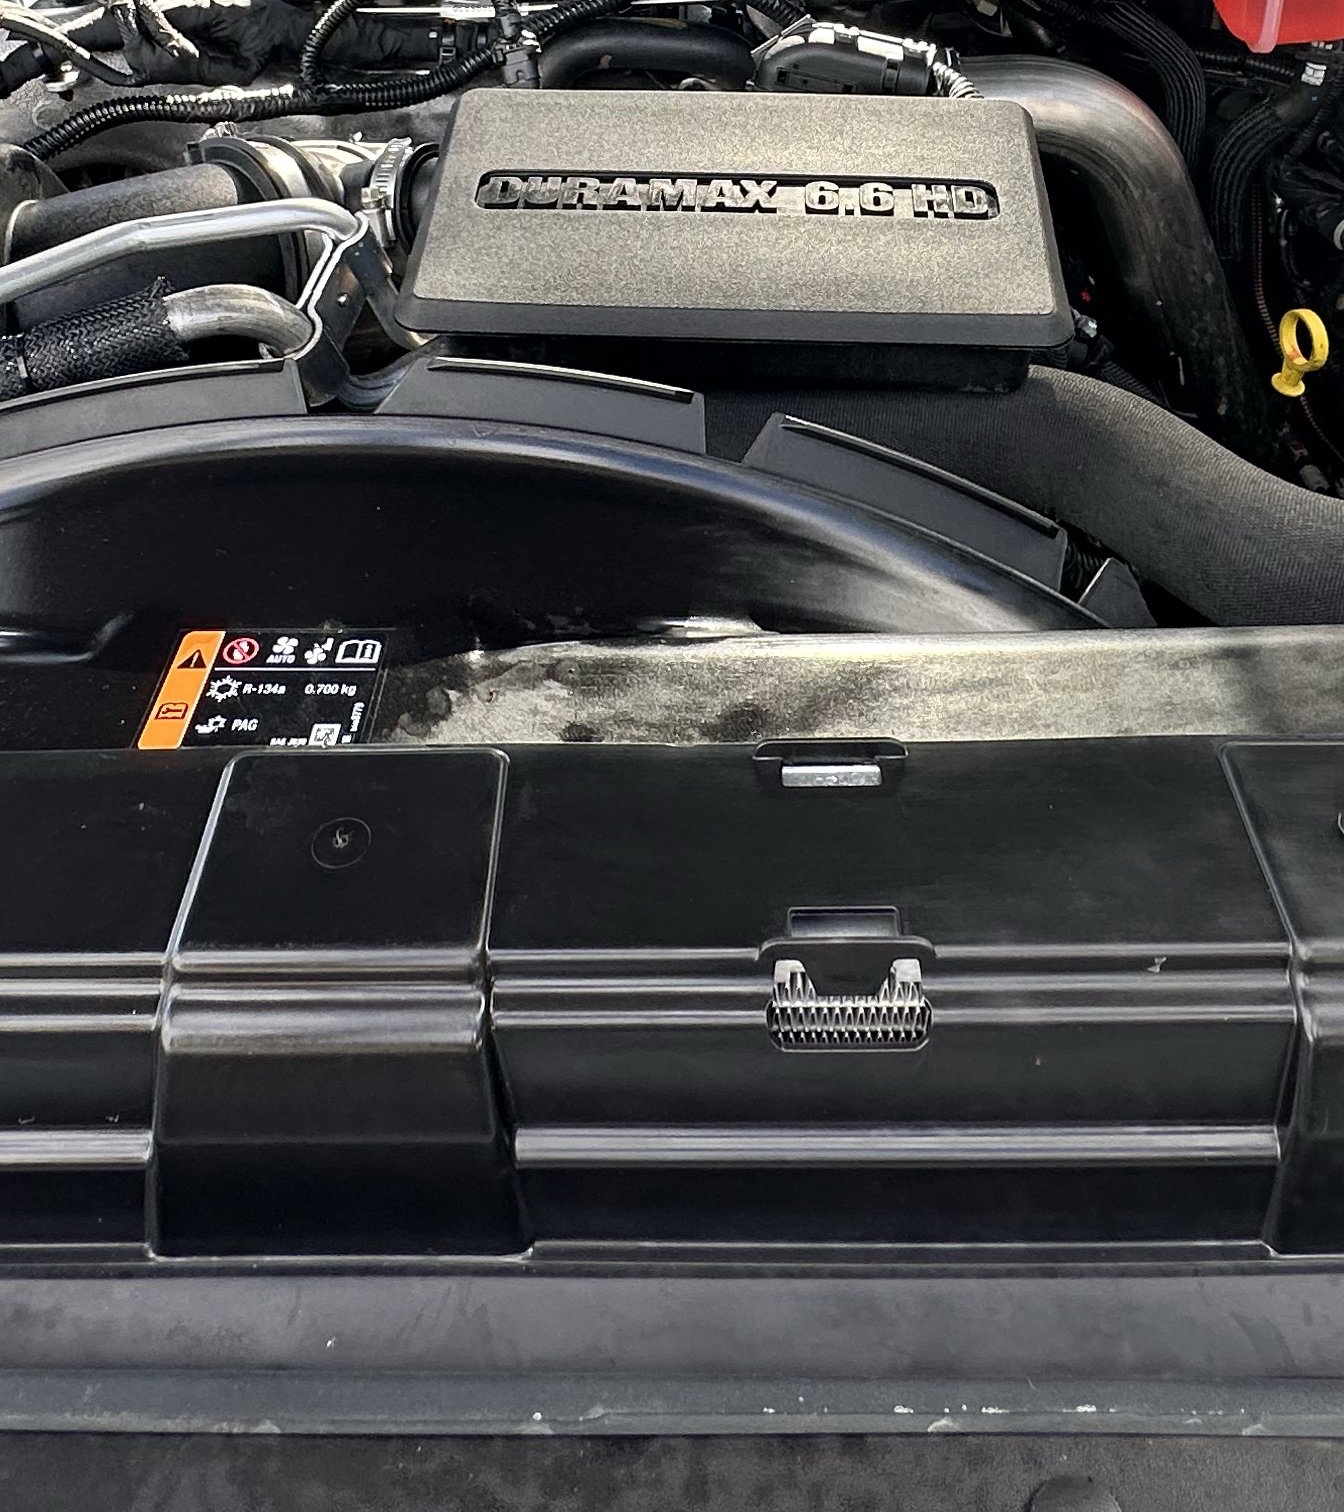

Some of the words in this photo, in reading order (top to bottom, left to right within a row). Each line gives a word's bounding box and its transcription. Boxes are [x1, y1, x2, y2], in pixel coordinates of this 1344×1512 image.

[478, 175, 778, 211] DURAMAX
[805, 180, 895, 215] 6.6
[910, 183, 990, 218] HD
[265, 654, 296, 664] AUTO
[242, 683, 286, 695] R-134a
[304, 683, 339, 695] 0.700
[340, 683, 357, 697] kg
[231, 718, 258, 731] PAG
